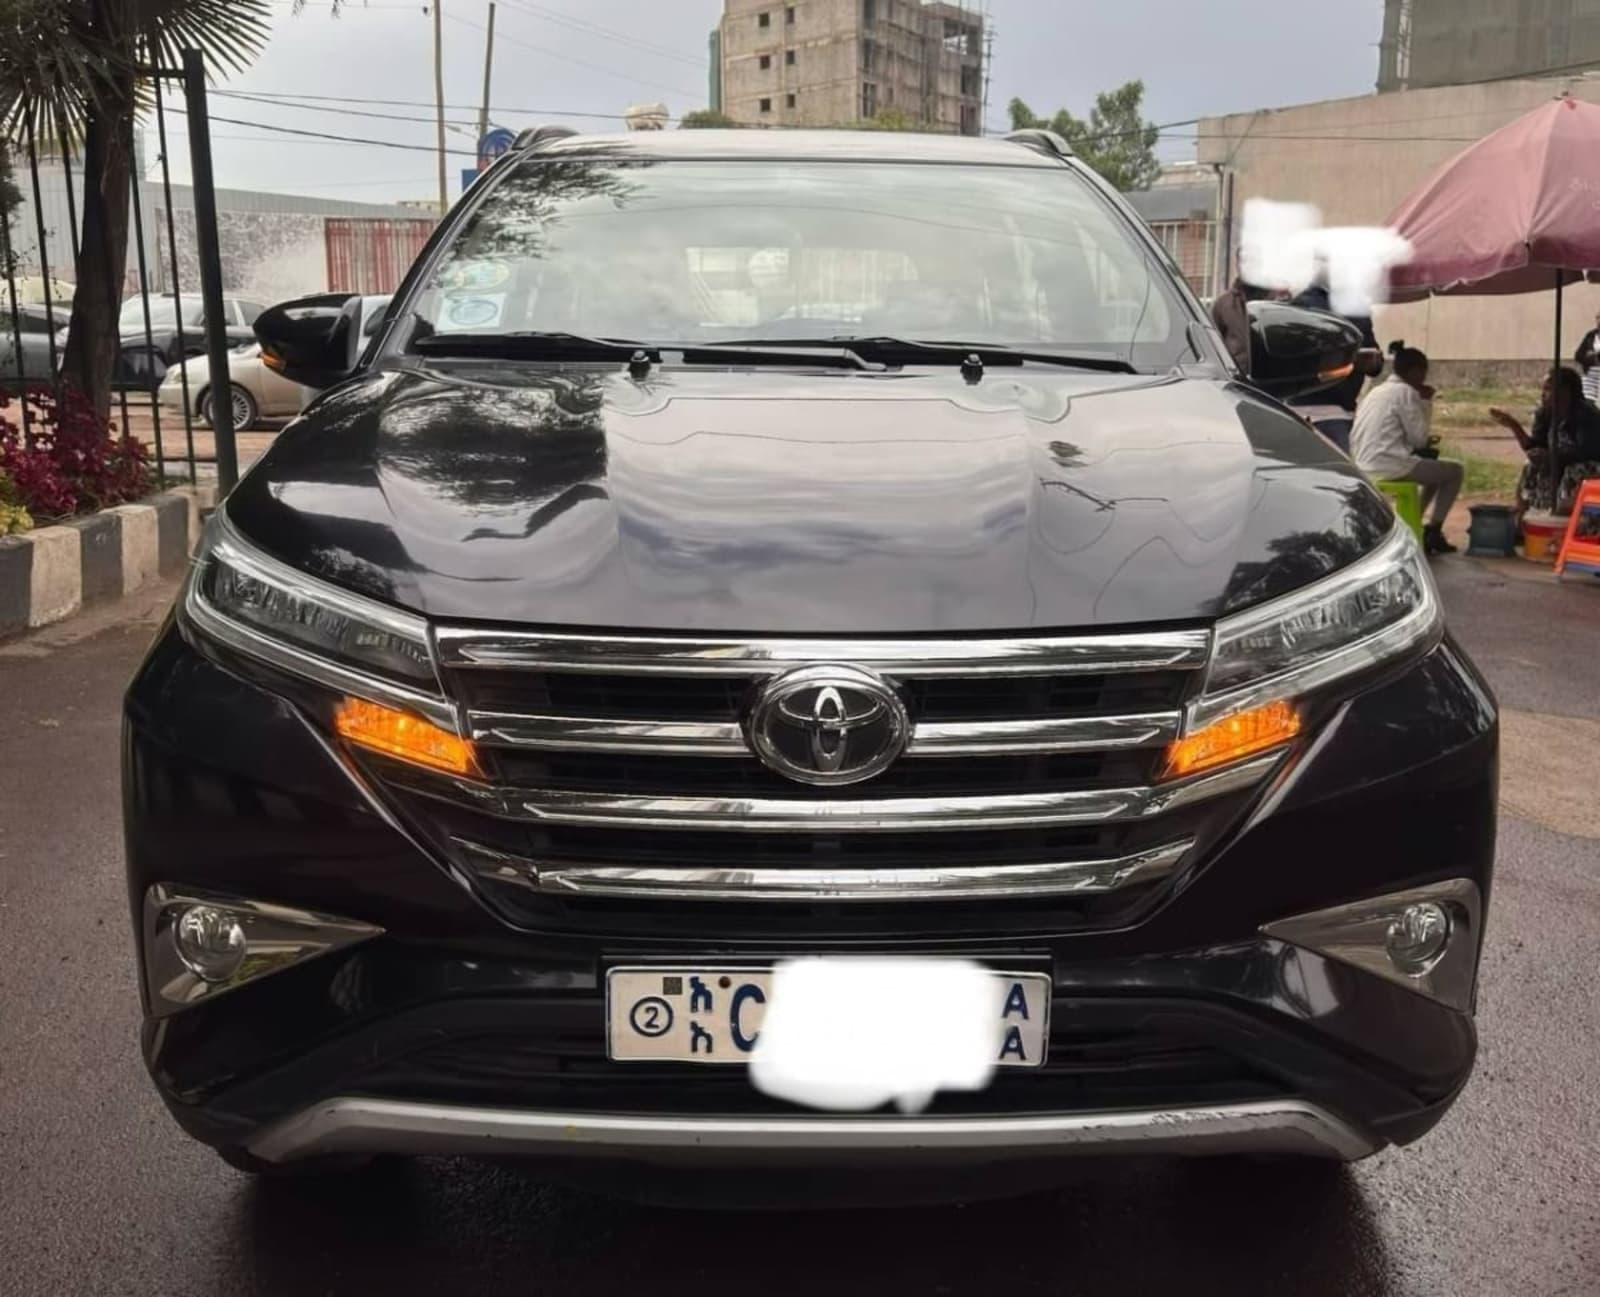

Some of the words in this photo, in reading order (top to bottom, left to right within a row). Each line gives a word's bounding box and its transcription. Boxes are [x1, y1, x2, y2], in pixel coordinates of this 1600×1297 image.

[730, 984, 766, 1053] C
[1002, 983, 1029, 1020] A
[999, 1025, 1026, 1060] A
